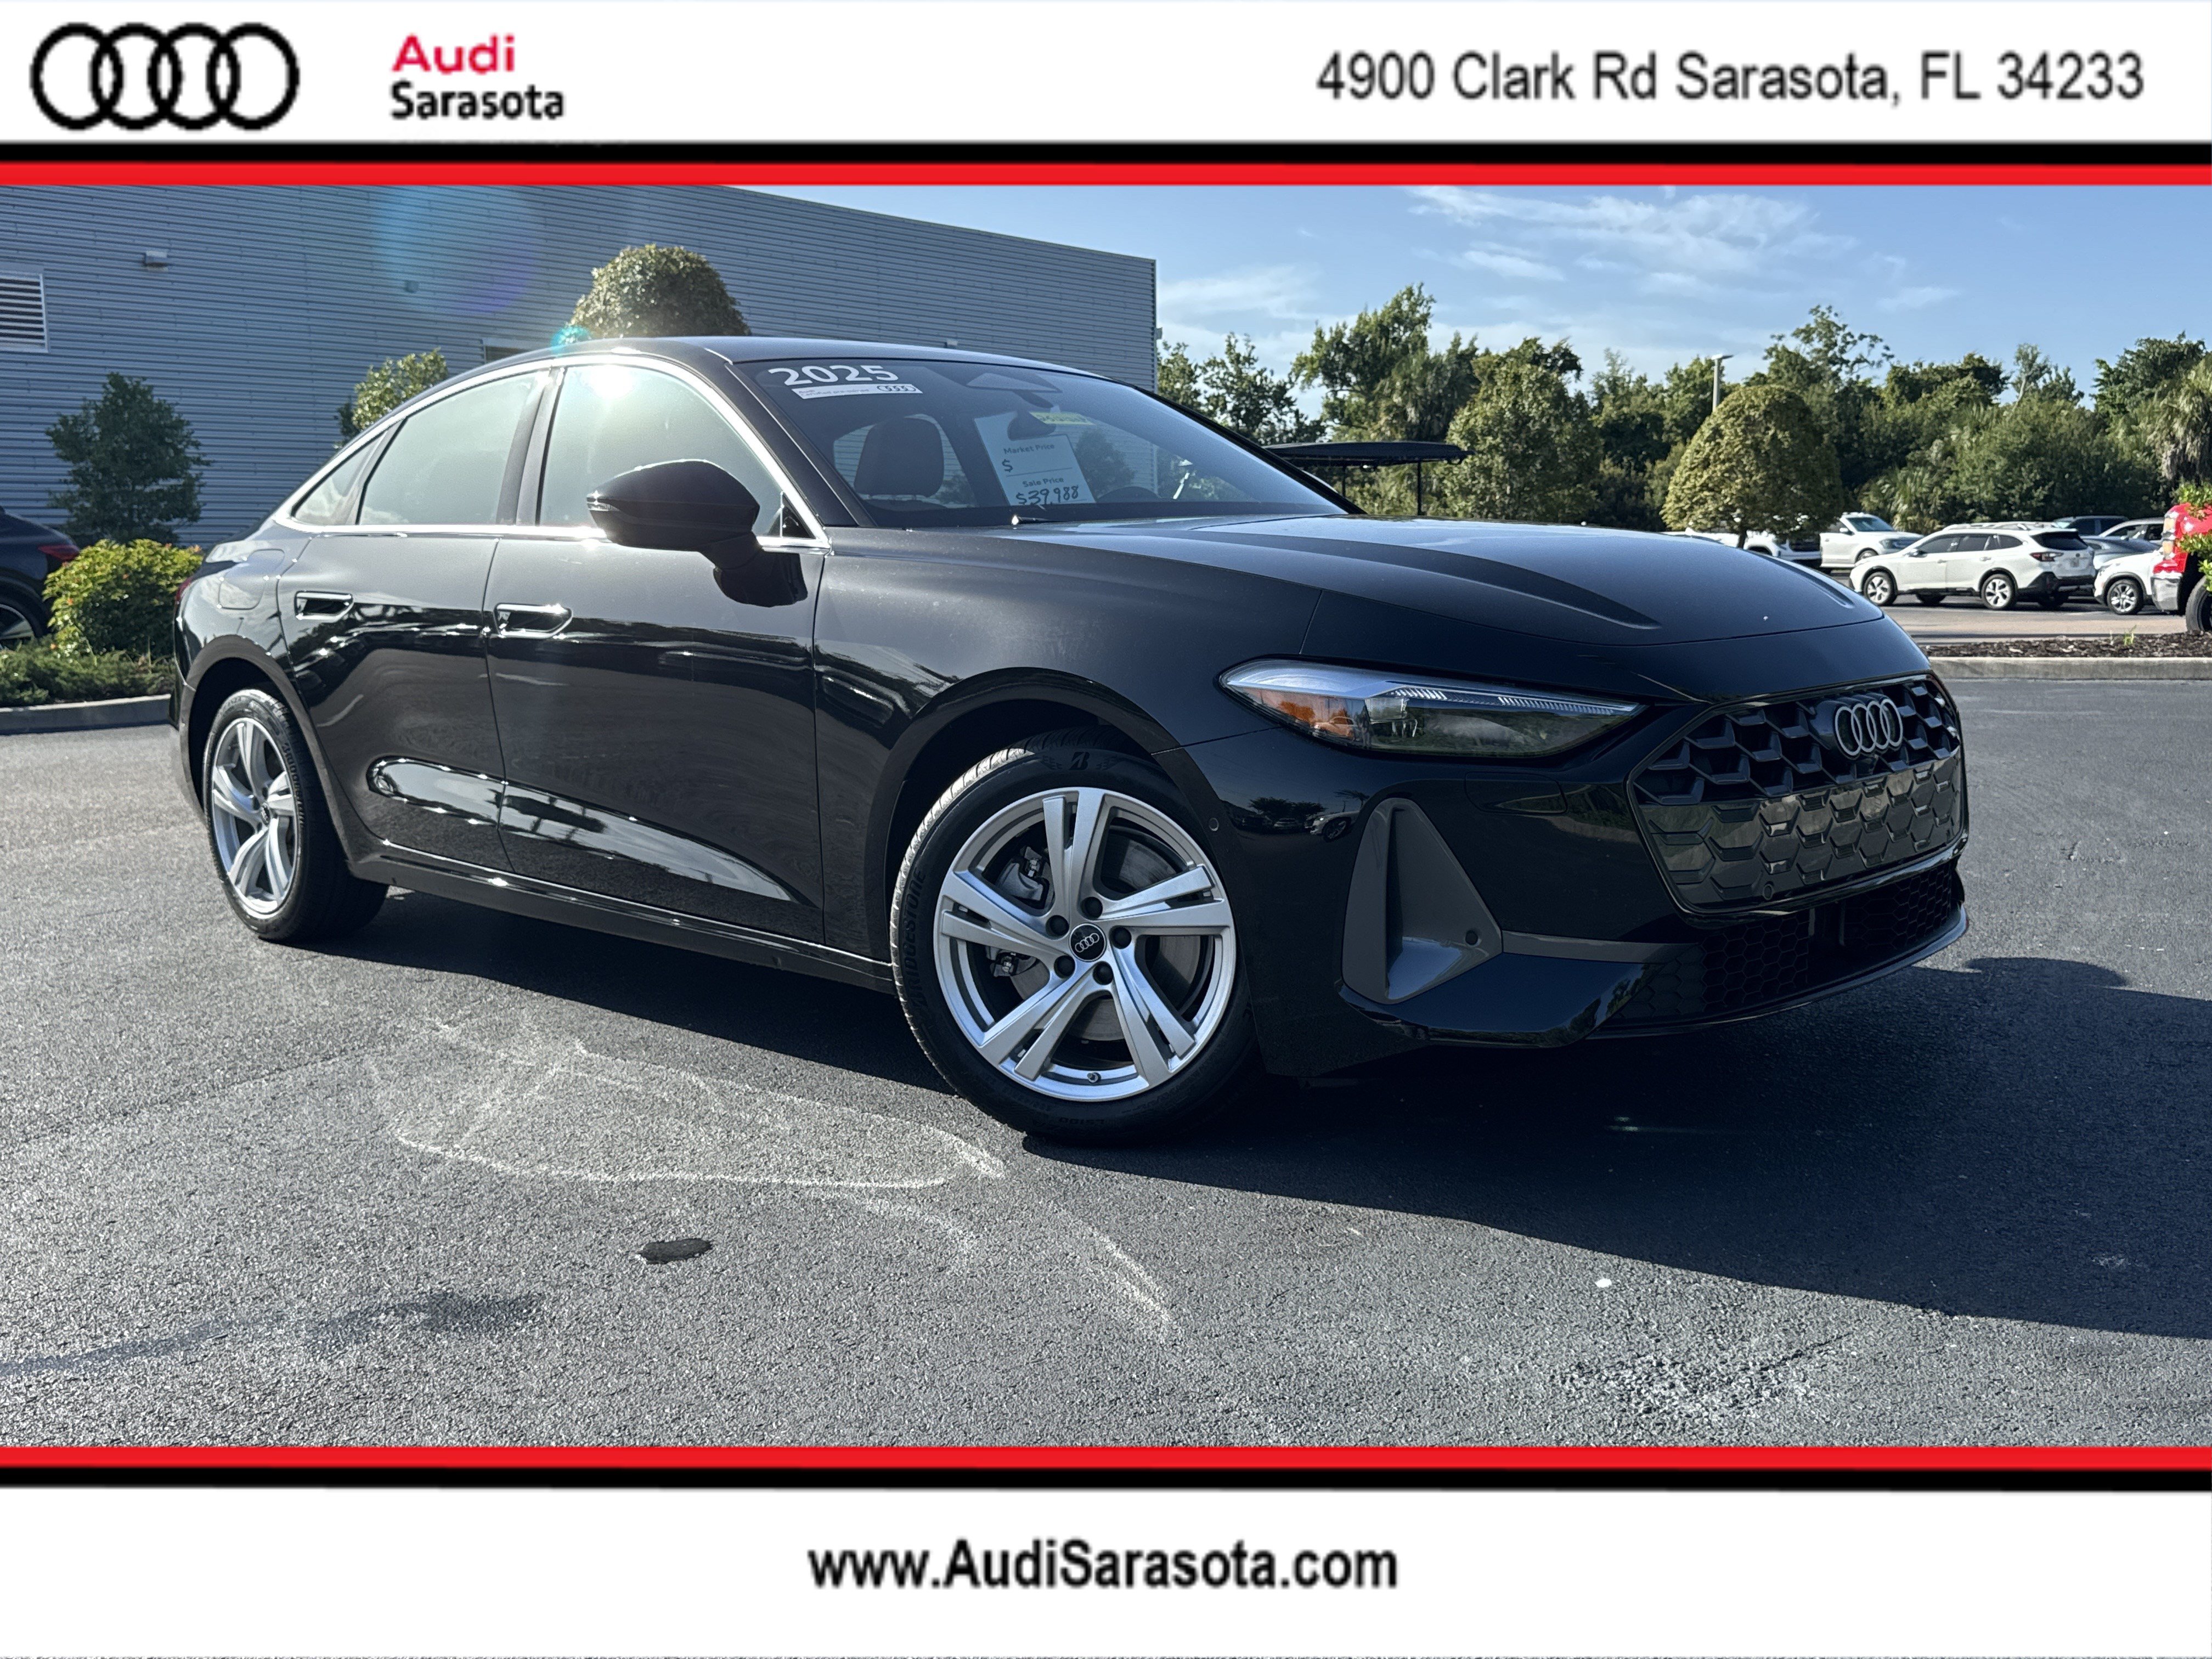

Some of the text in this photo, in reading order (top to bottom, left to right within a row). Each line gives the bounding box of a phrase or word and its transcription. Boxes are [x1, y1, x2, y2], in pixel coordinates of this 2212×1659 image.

[768, 365, 899, 386] 2025
[1003, 446, 1034, 454] Market
[1002, 459, 1013, 472] $
